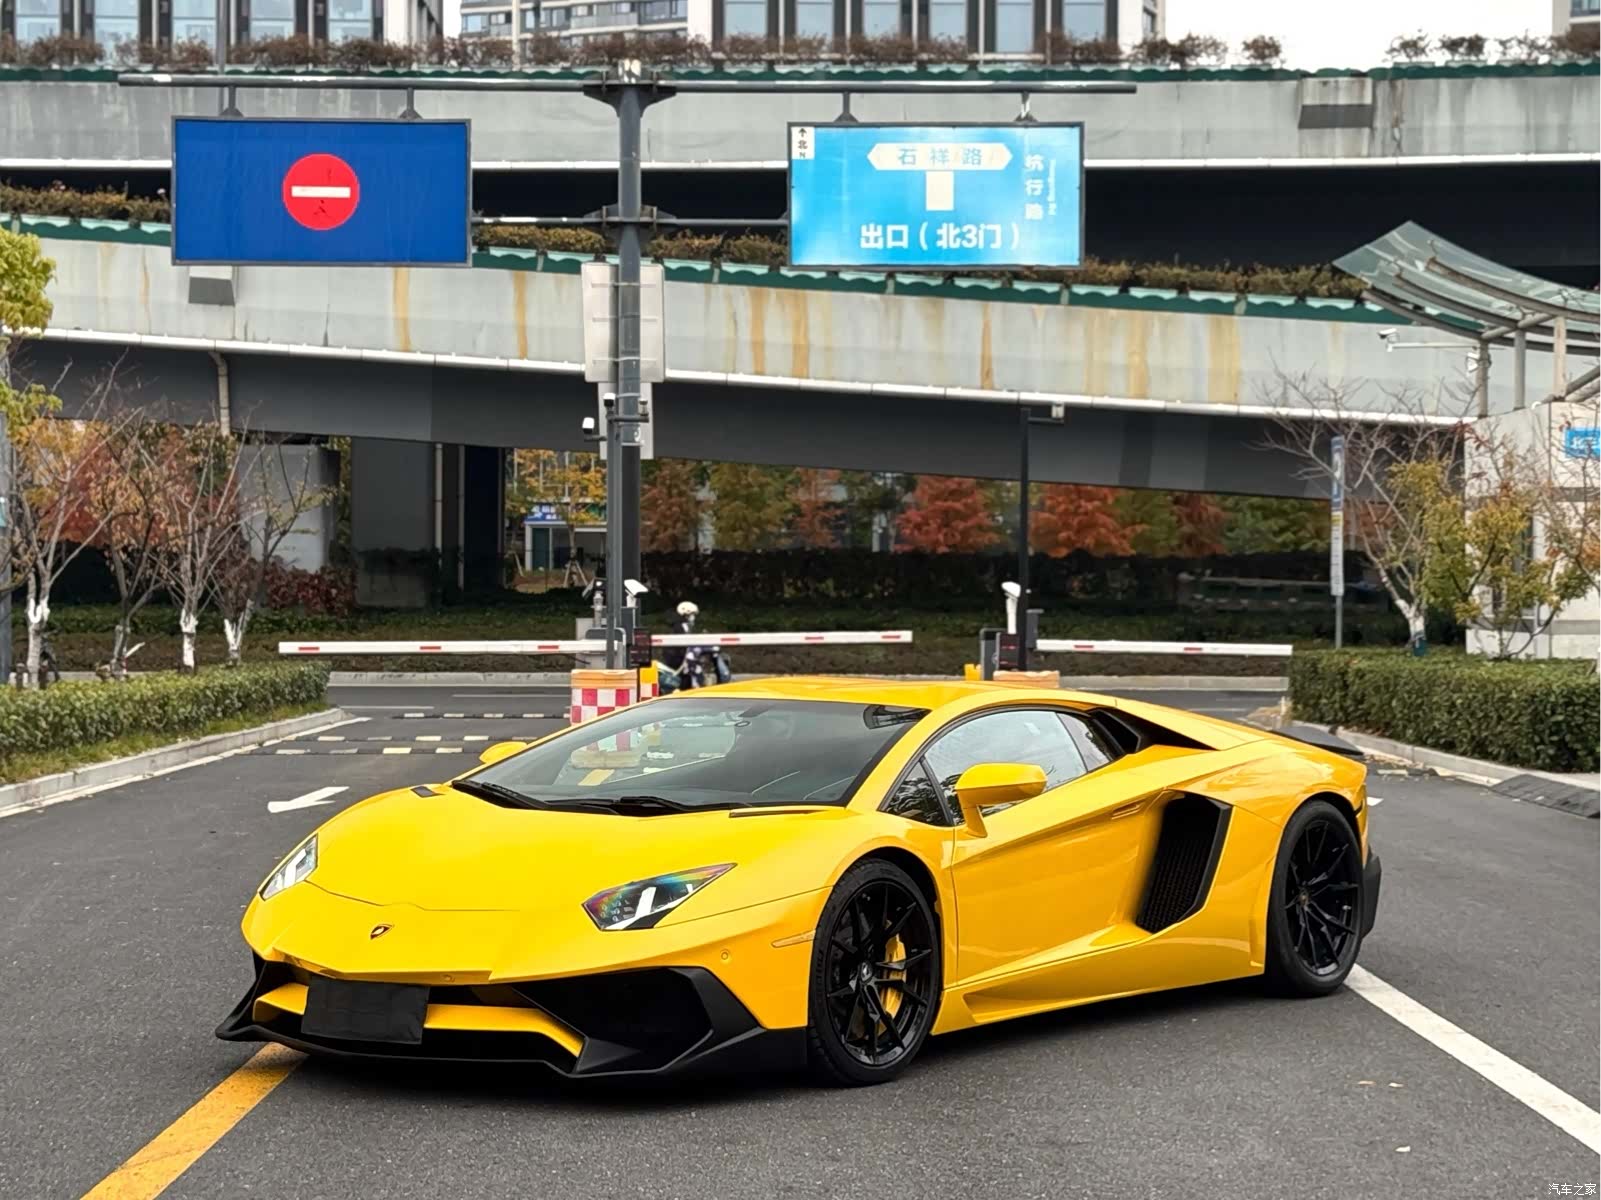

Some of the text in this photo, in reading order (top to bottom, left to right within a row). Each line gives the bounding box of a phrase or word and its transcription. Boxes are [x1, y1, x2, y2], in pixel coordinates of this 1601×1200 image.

[797, 139, 808, 150] 北
[798, 151, 806, 159] N
[898, 148, 983, 166] 石祥路
